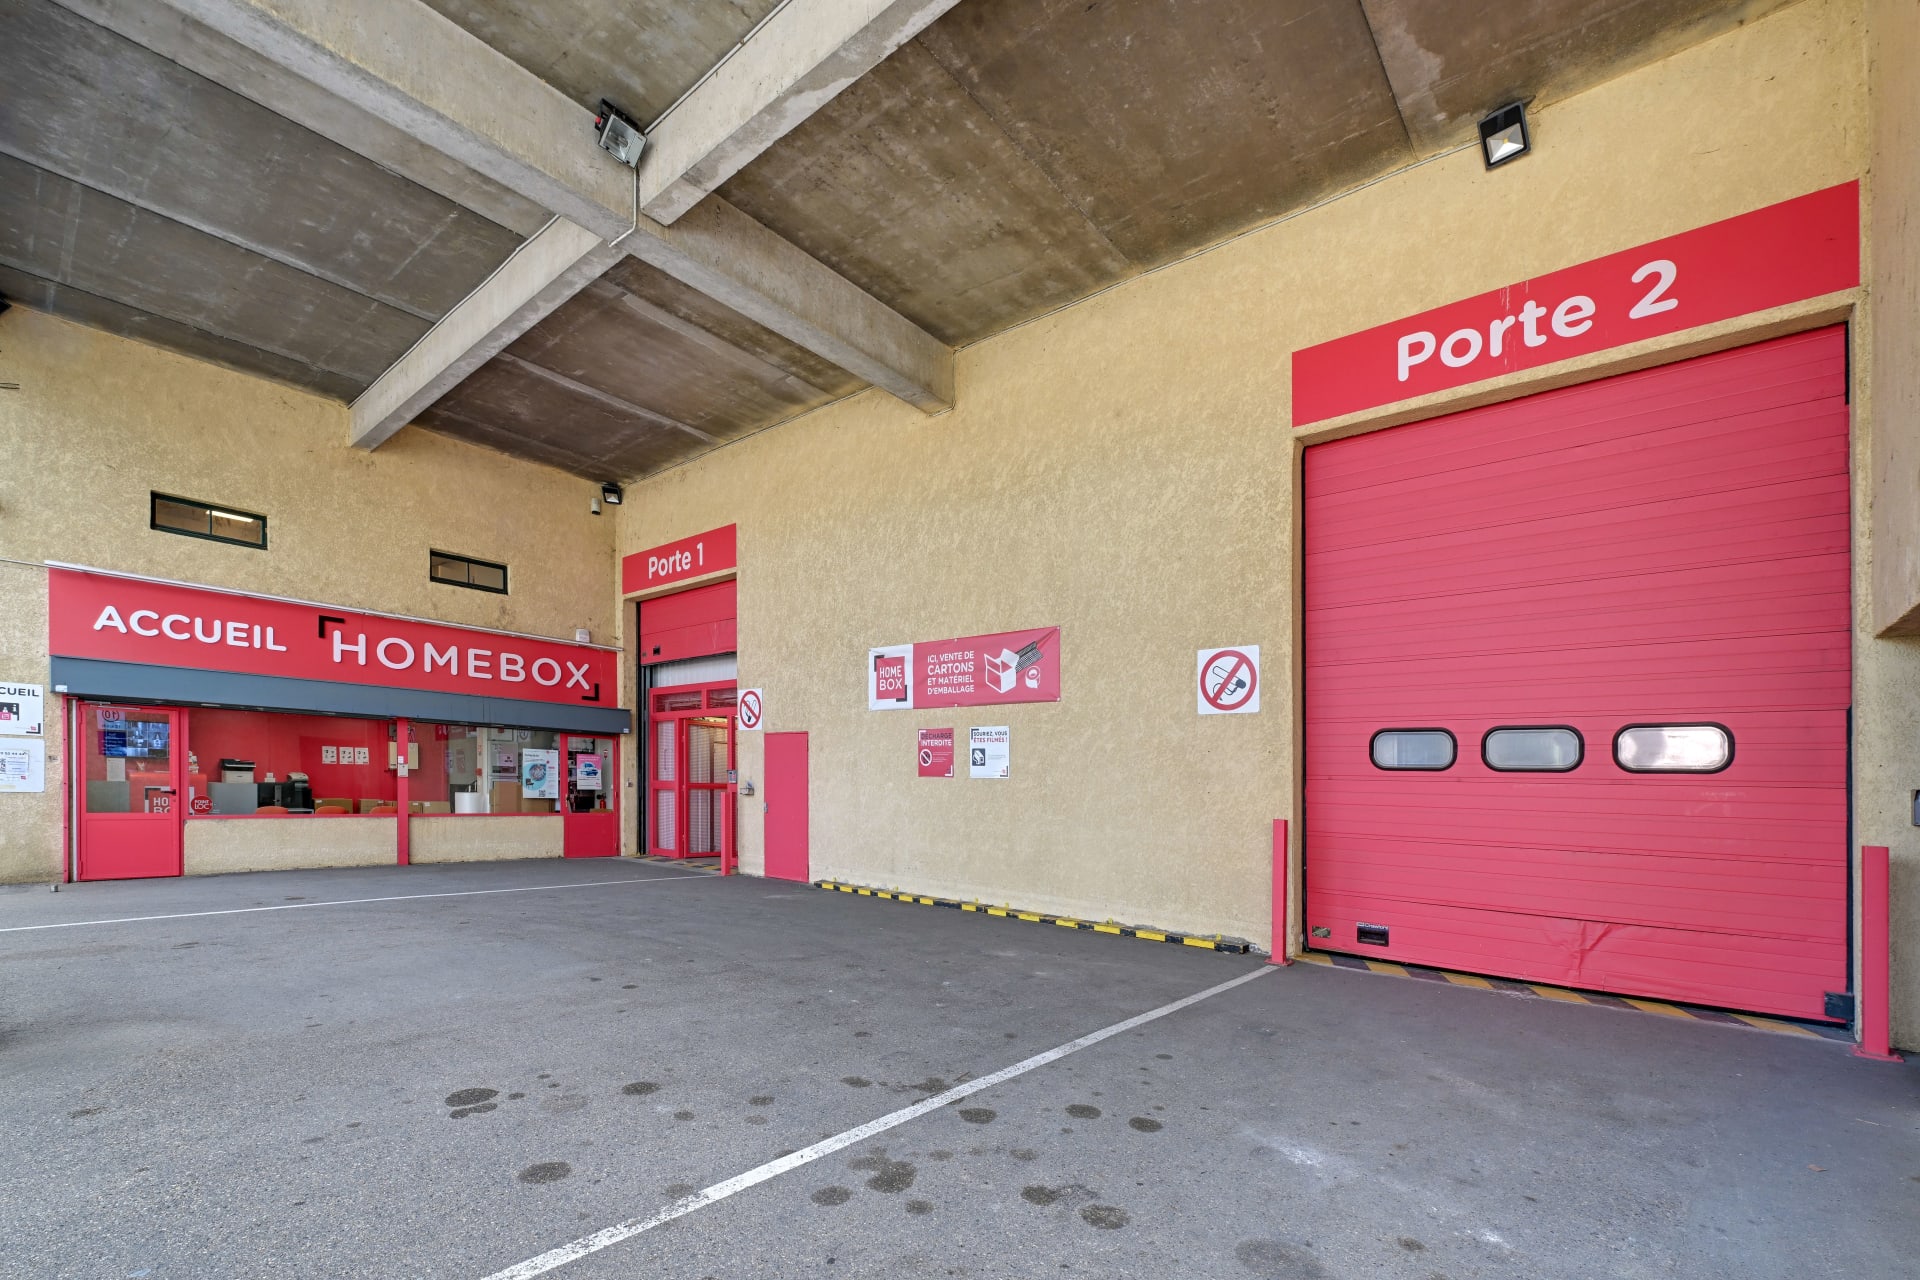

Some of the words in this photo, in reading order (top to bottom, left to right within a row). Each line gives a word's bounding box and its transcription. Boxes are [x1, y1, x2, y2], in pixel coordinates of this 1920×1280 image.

[1398, 295, 1596, 382] Porte
[1628, 259, 1679, 320] 2
[648, 555, 691, 579] Porte
[696, 542, 704, 566] 1
[93, 605, 288, 652] ACCUEIL
[332, 629, 590, 690] HOMEBOX
[927, 654, 939, 663] ICI,
[940, 652, 963, 662] VENTE
[964, 650, 975, 660] DE
[879, 665, 903, 679] HOME
[927, 661, 975, 676] CARTONS
[879, 678, 903, 691] BOX
[927, 677, 937, 686] ET
[938, 674, 975, 685] MATÉRIEL
[927, 684, 975, 695] D'EMBALLAGE
[921, 739, 953, 747] INTERDITE
